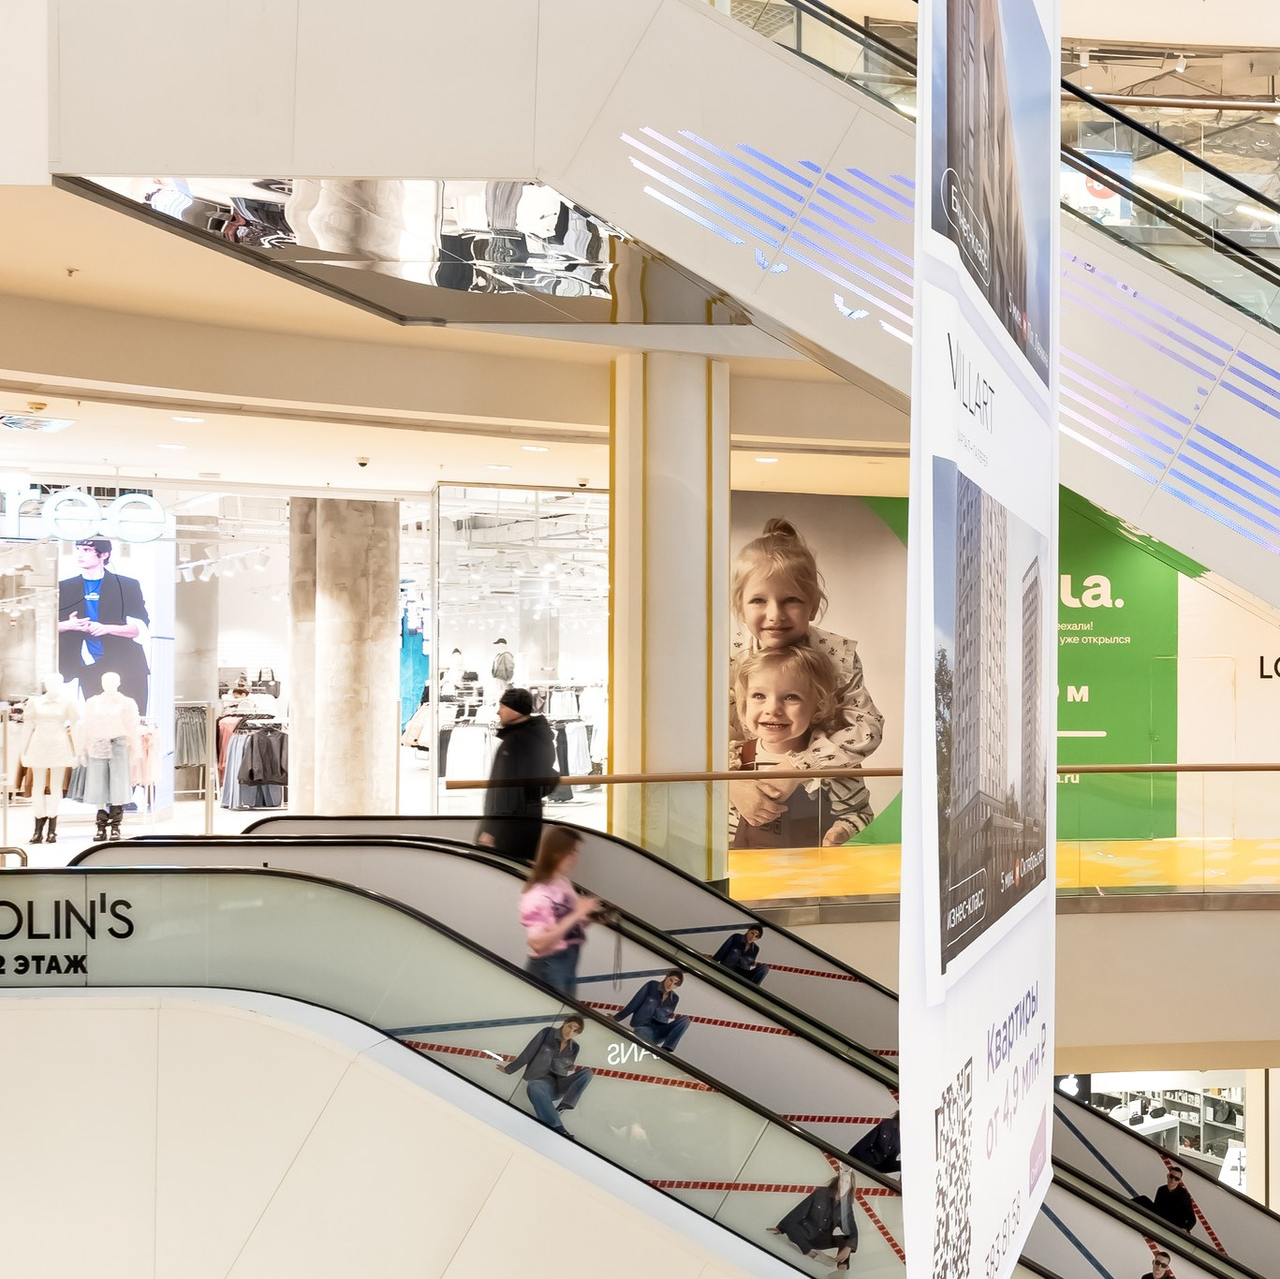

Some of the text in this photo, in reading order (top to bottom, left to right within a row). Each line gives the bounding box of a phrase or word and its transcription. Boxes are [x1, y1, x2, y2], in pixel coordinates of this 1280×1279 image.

[1060, 635, 1131, 646] уже открылся
[13, 954, 89, 975] ЭТАЖ
[987, 980, 1039, 1083] Квартиры
[1002, 1065, 1019, 1132] 4,9
